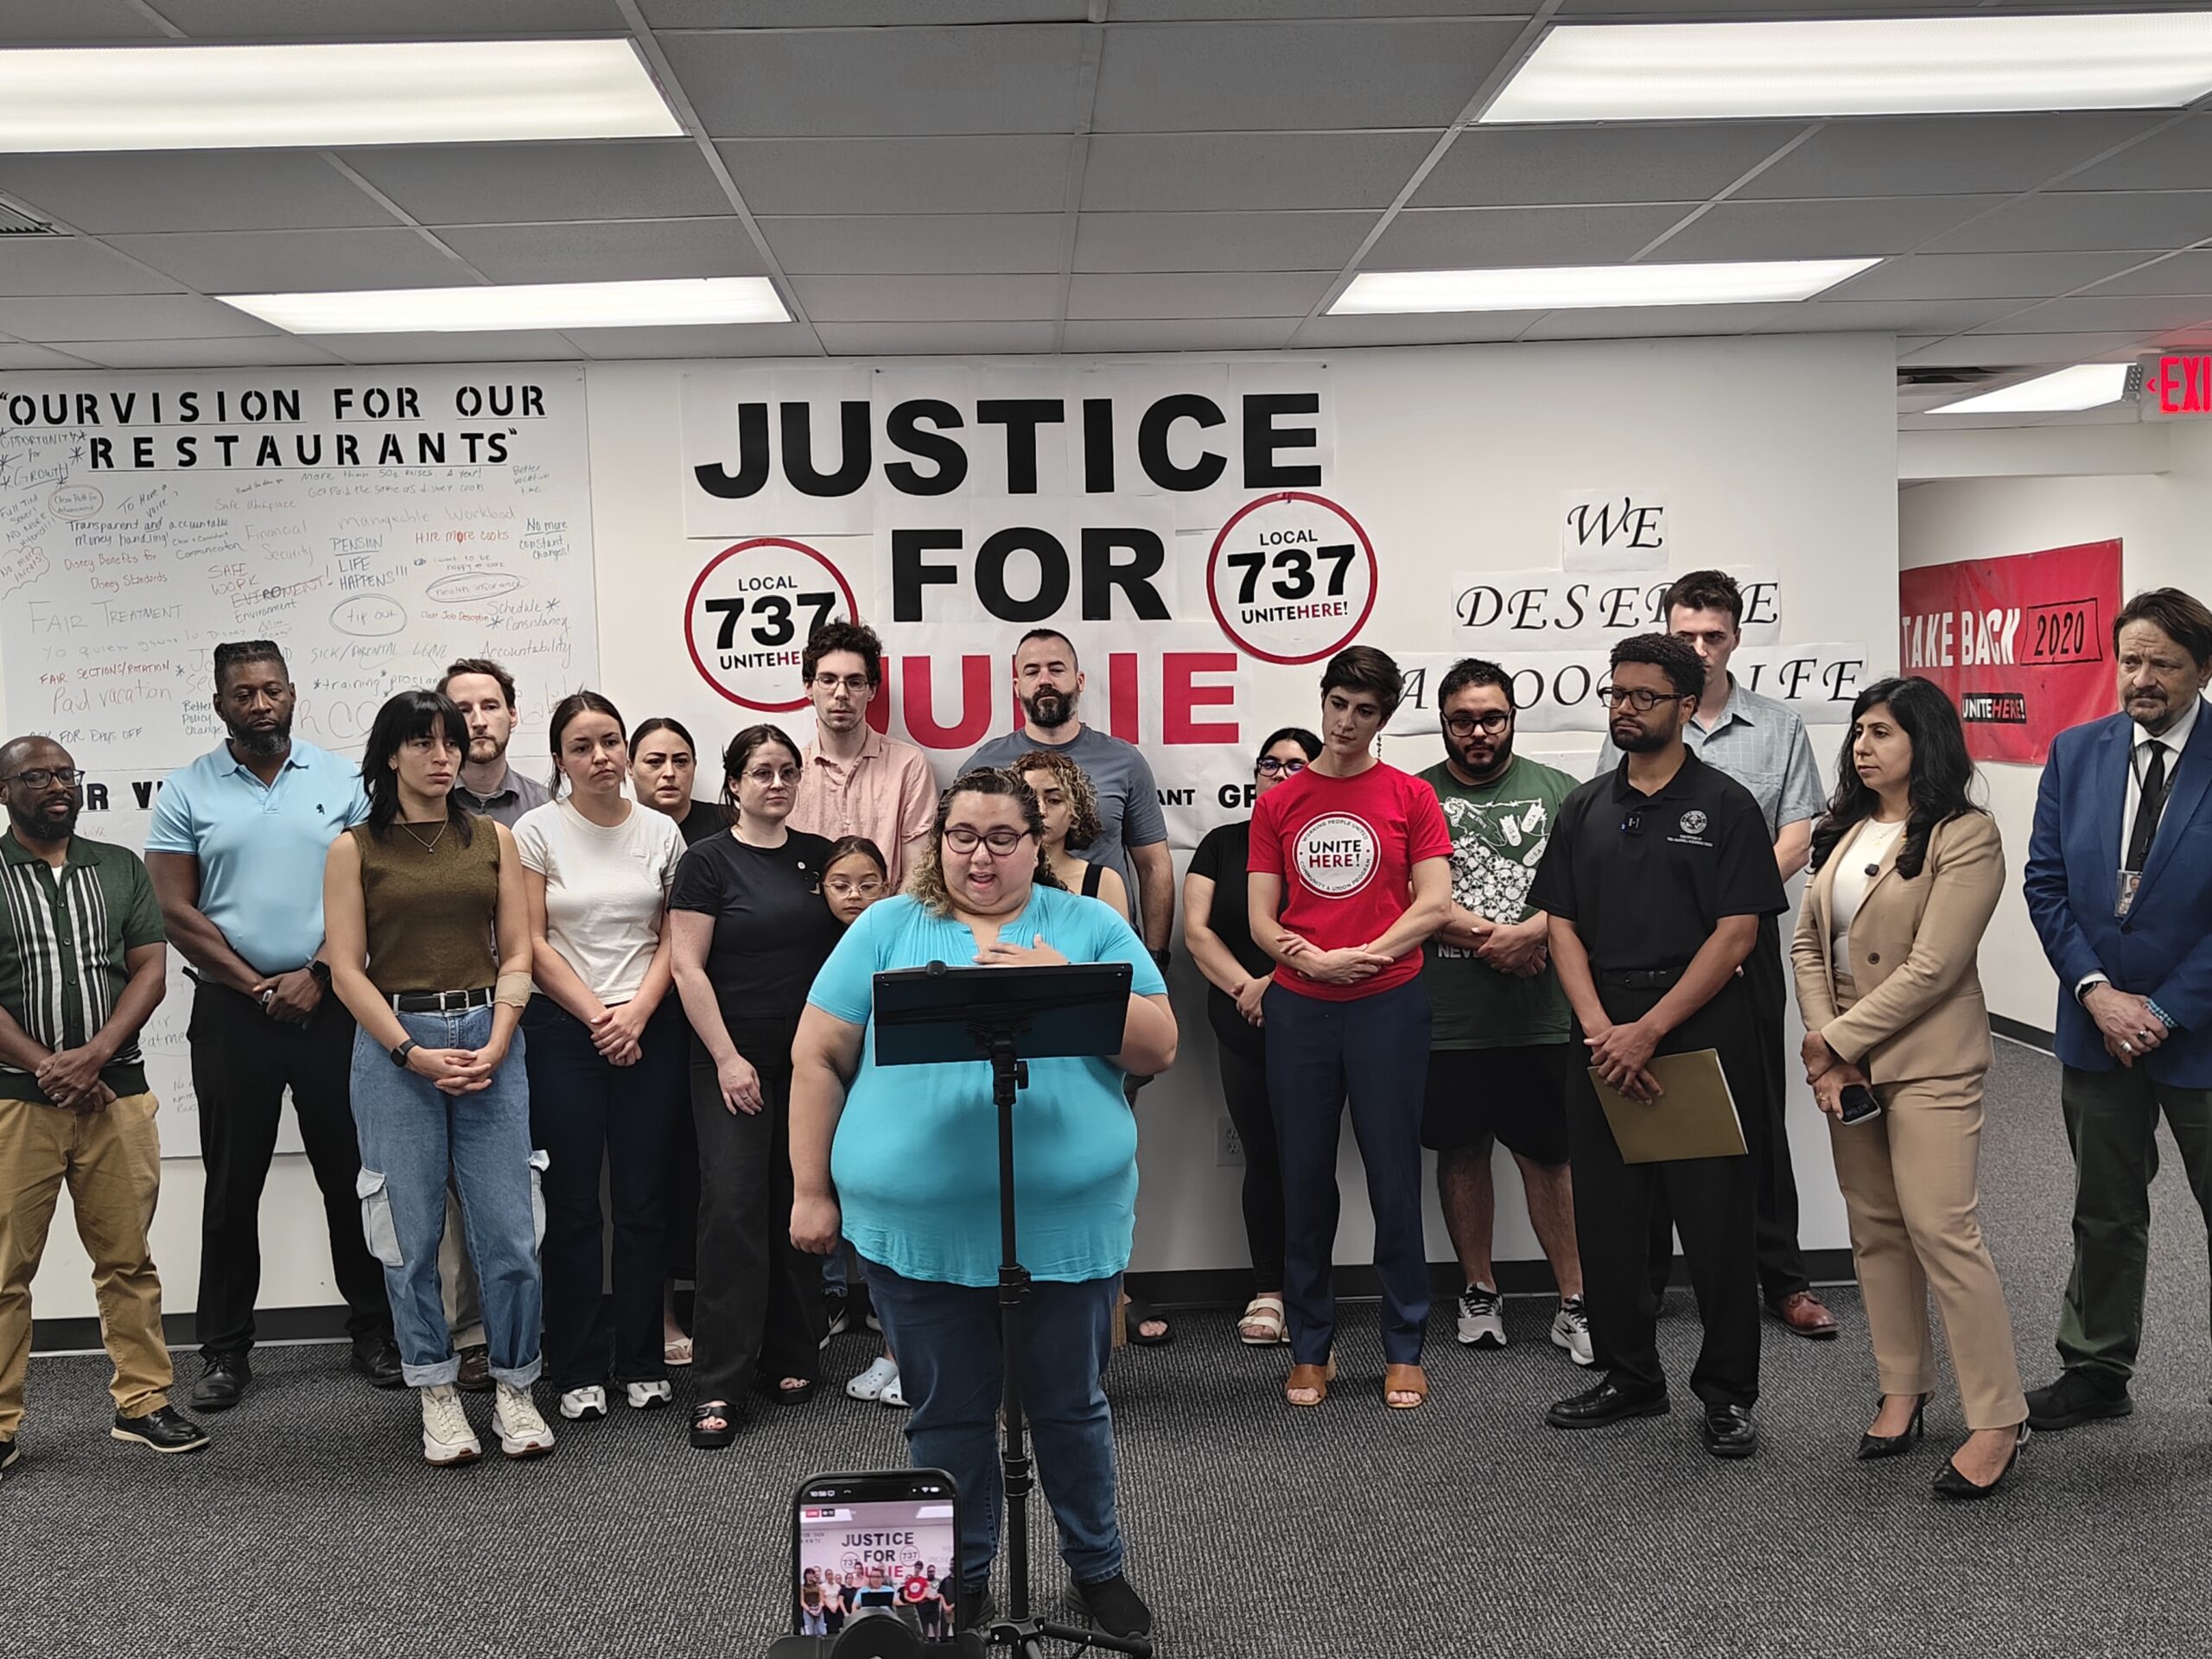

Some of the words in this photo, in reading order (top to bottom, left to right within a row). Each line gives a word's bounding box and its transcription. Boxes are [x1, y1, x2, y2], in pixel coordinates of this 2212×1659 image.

[2160, 354, 2212, 414] EXI
[334, 387, 421, 420] FOR
[455, 385, 546, 416] OUR
[694, 391, 1323, 499] JUSTICE
[66, 519, 139, 533] Transparent
[526, 518, 541, 531] No
[1567, 497, 1664, 549] WE
[1259, 529, 1319, 546] LOCAL
[207, 563, 249, 580] SAFE
[339, 556, 371, 573] LIFE
[891, 526, 1173, 623] FOR
[1227, 543, 1356, 605] 737
[738, 575, 798, 592] LOCAL
[29, 601, 90, 634] FAIR
[91, 599, 184, 627] TREATMENT
[704, 592, 836, 650] 737
[1901, 611, 1955, 668] TAKE
[1961, 607, 2021, 666] BACK
[2033, 609, 2085, 658] 2020
[720, 651, 801, 670] UNITEHE
[40, 673, 69, 685] FAIR
[1397, 667, 1429, 710] A
[1747, 658, 1867, 702] IFE
[181, 700, 212, 713] Better
[59, 728, 85, 744] FOR
[1302, 822, 1326, 842] WORKING
[1351, 823, 1369, 841] UNITED
[1308, 839, 1362, 854] UNITE
[1309, 853, 1360, 868] HERE!
[1300, 861, 1325, 888] COMMUNITY
[1352, 858, 1371, 886] PROGRAM
[842, 1531, 914, 1548] JUSTICE
[863, 1549, 896, 1563] FOR
